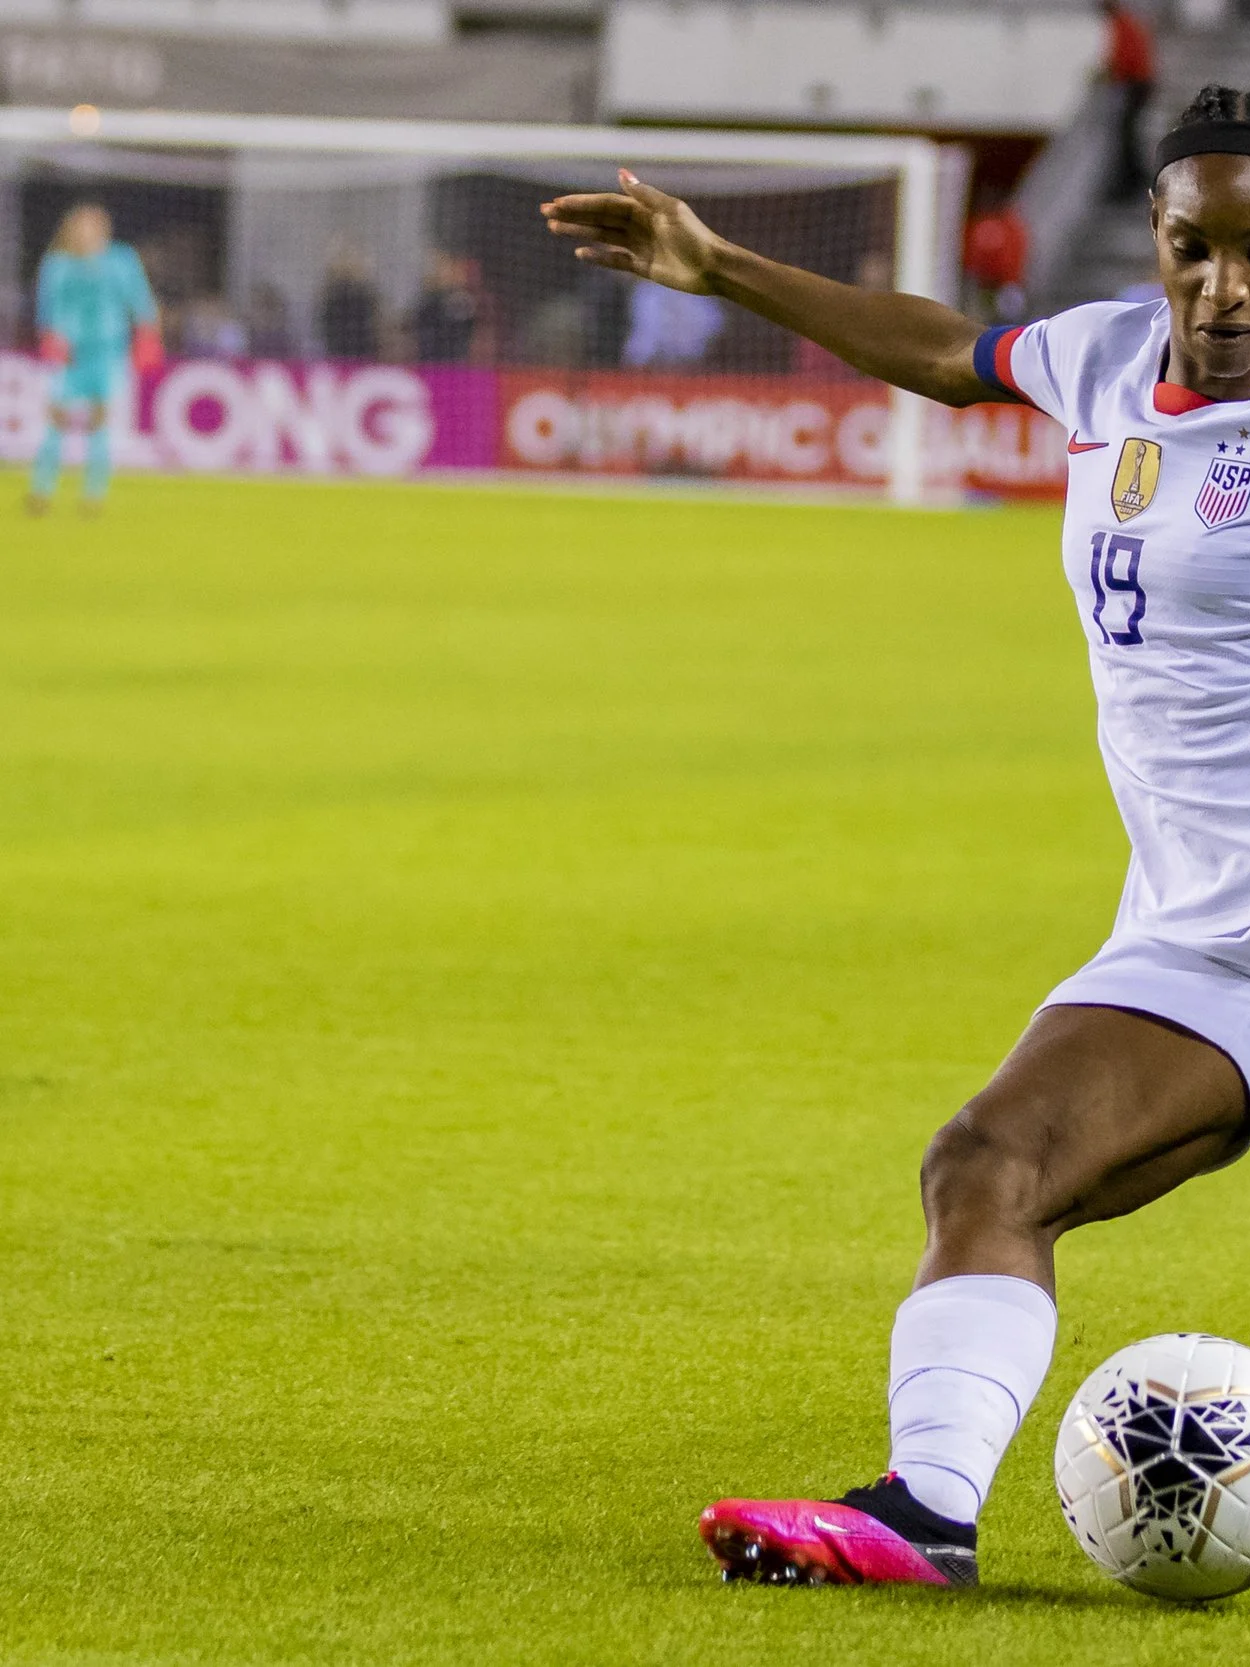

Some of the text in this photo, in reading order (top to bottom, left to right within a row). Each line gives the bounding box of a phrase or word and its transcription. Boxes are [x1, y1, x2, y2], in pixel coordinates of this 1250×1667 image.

[0, 356, 434, 474] BLONG
[508, 392, 832, 474] OLYMPIC
[1121, 489, 1142, 506] FIFA
[1090, 531, 1147, 645] 19
